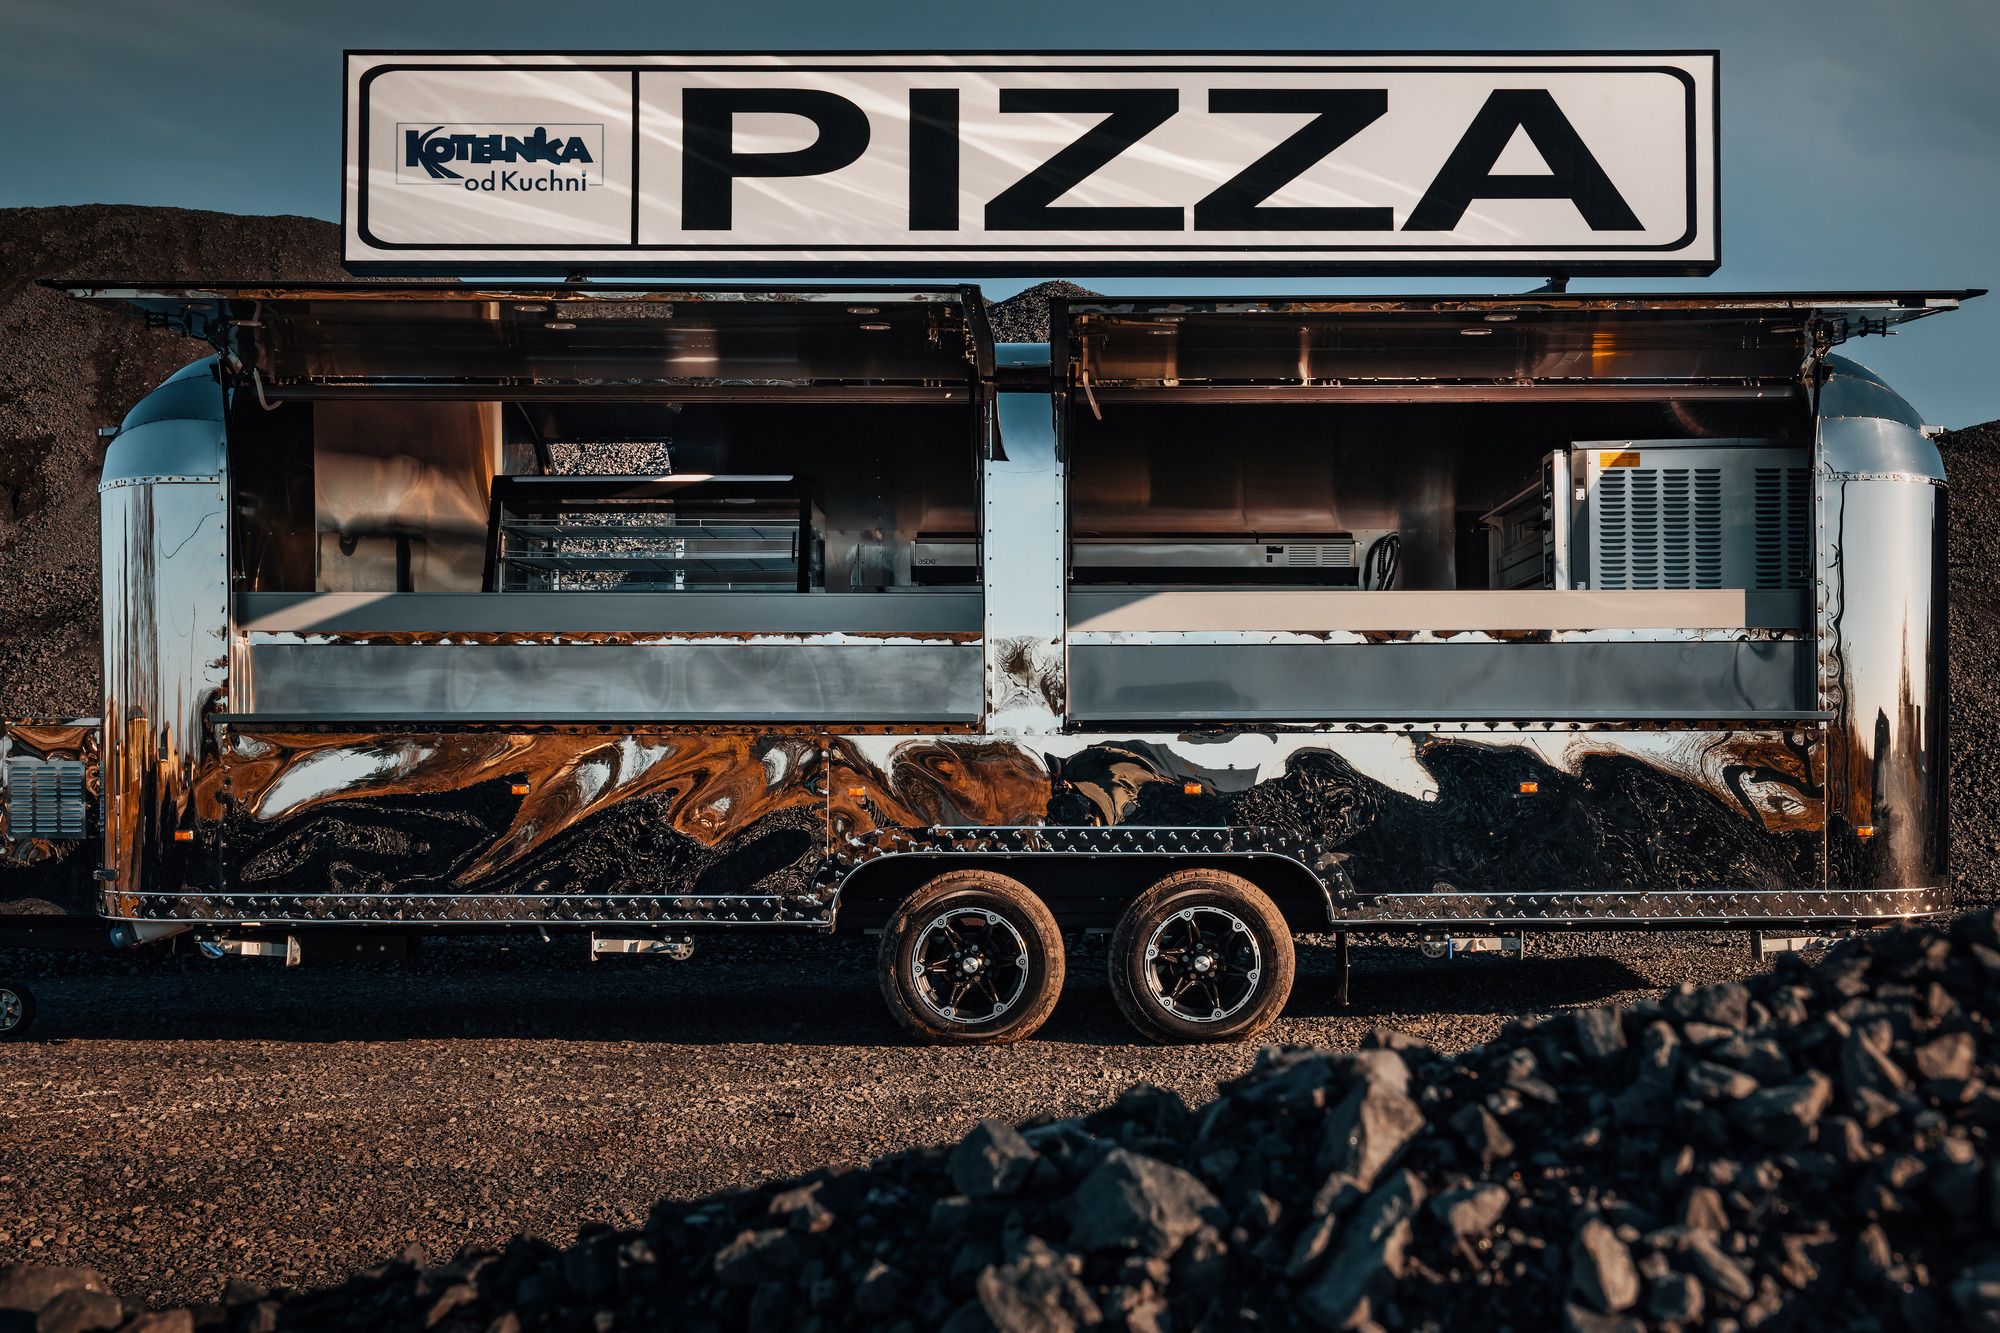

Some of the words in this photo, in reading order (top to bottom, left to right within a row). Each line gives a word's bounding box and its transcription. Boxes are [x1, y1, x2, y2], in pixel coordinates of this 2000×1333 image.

[465, 171, 495, 192] od
[502, 169, 588, 192] Kuchni
[682, 88, 1645, 231] PIZZA
